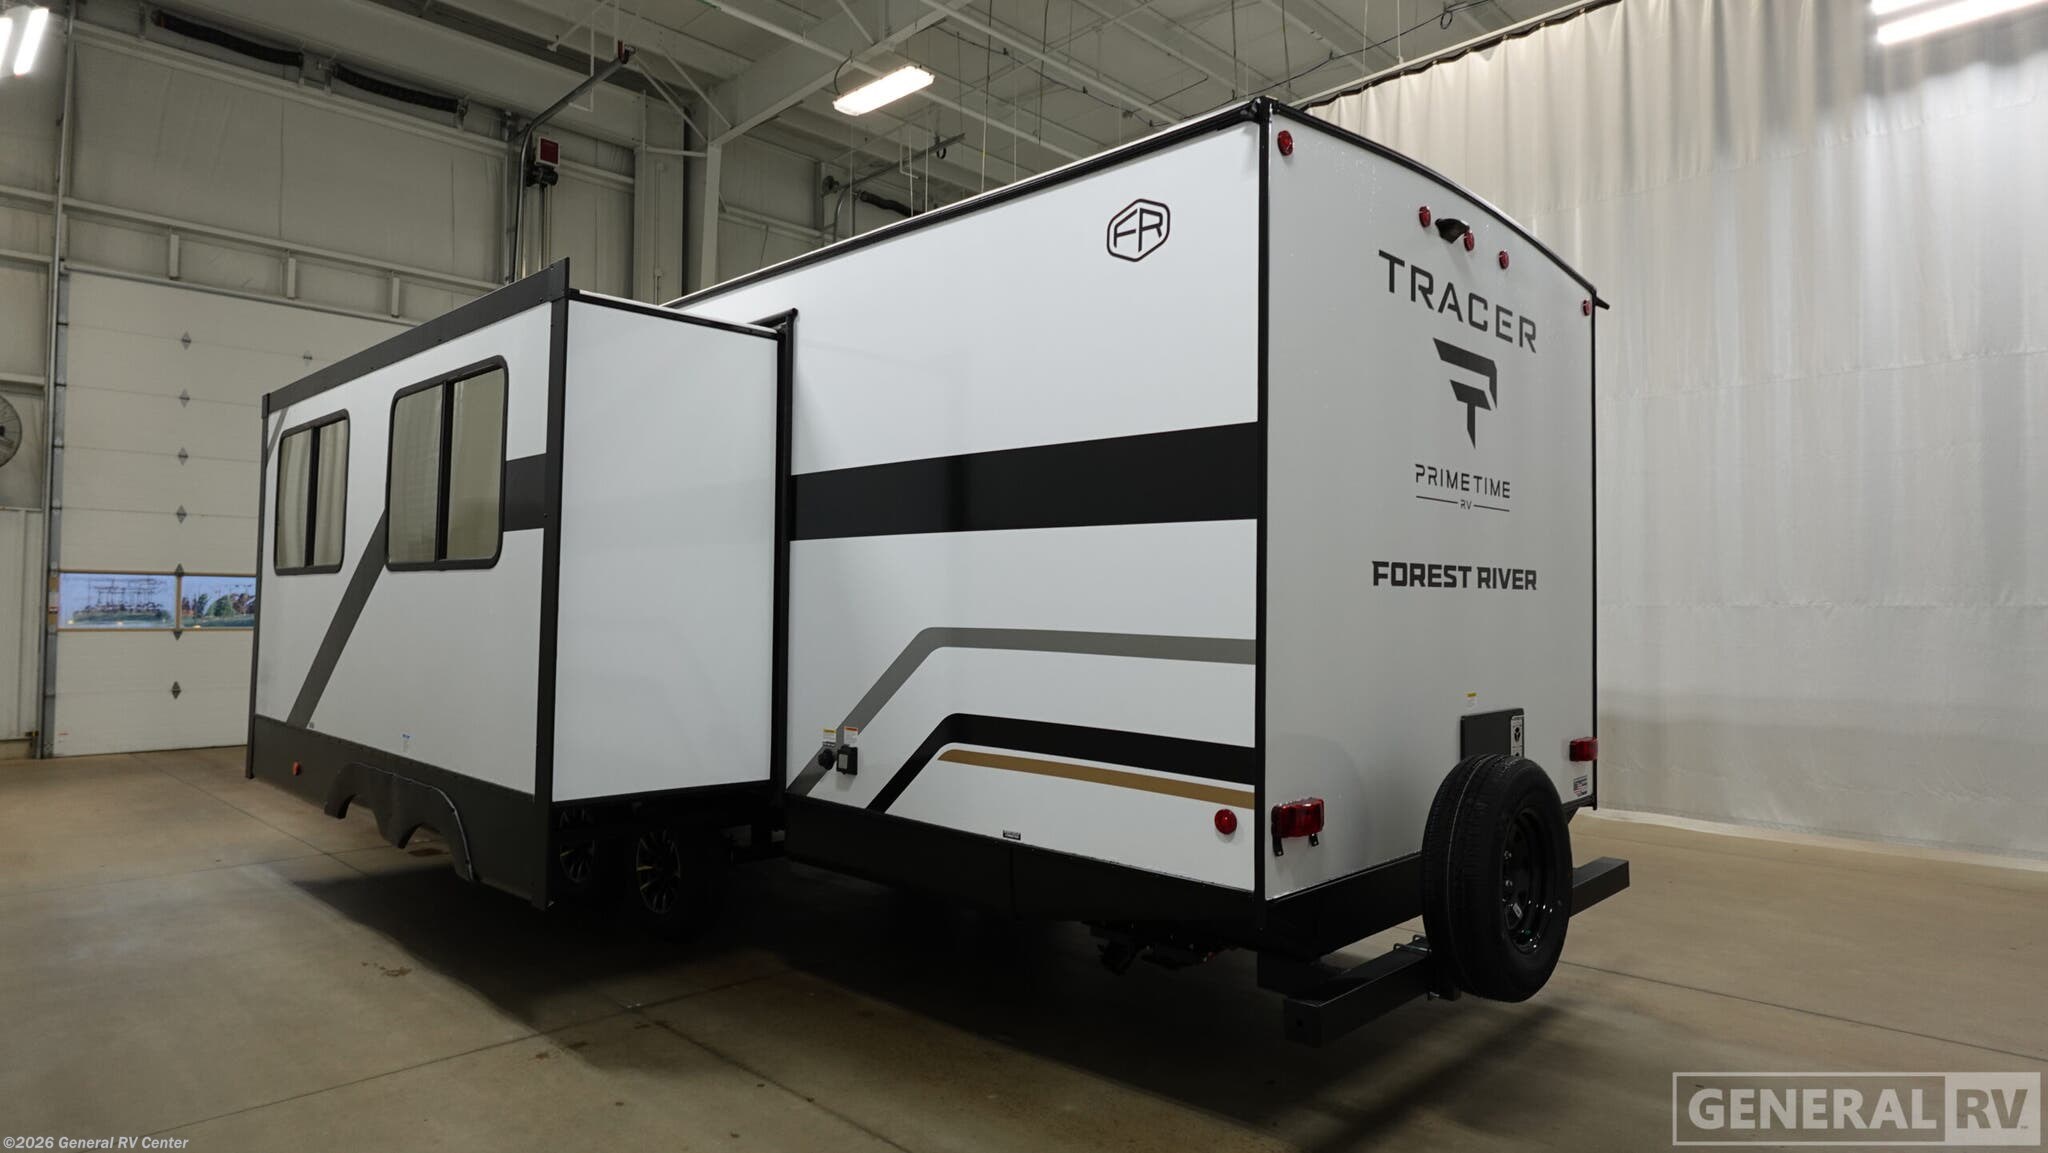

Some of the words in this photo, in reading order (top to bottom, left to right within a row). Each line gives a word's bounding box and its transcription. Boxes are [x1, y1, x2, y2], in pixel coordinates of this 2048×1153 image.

[1113, 207, 1164, 253] FR
[1378, 249, 1537, 354] TRACER
[1460, 499, 1472, 510] RV
[1372, 560, 1472, 589] FOREST
[1476, 566, 1537, 591] RIVER
